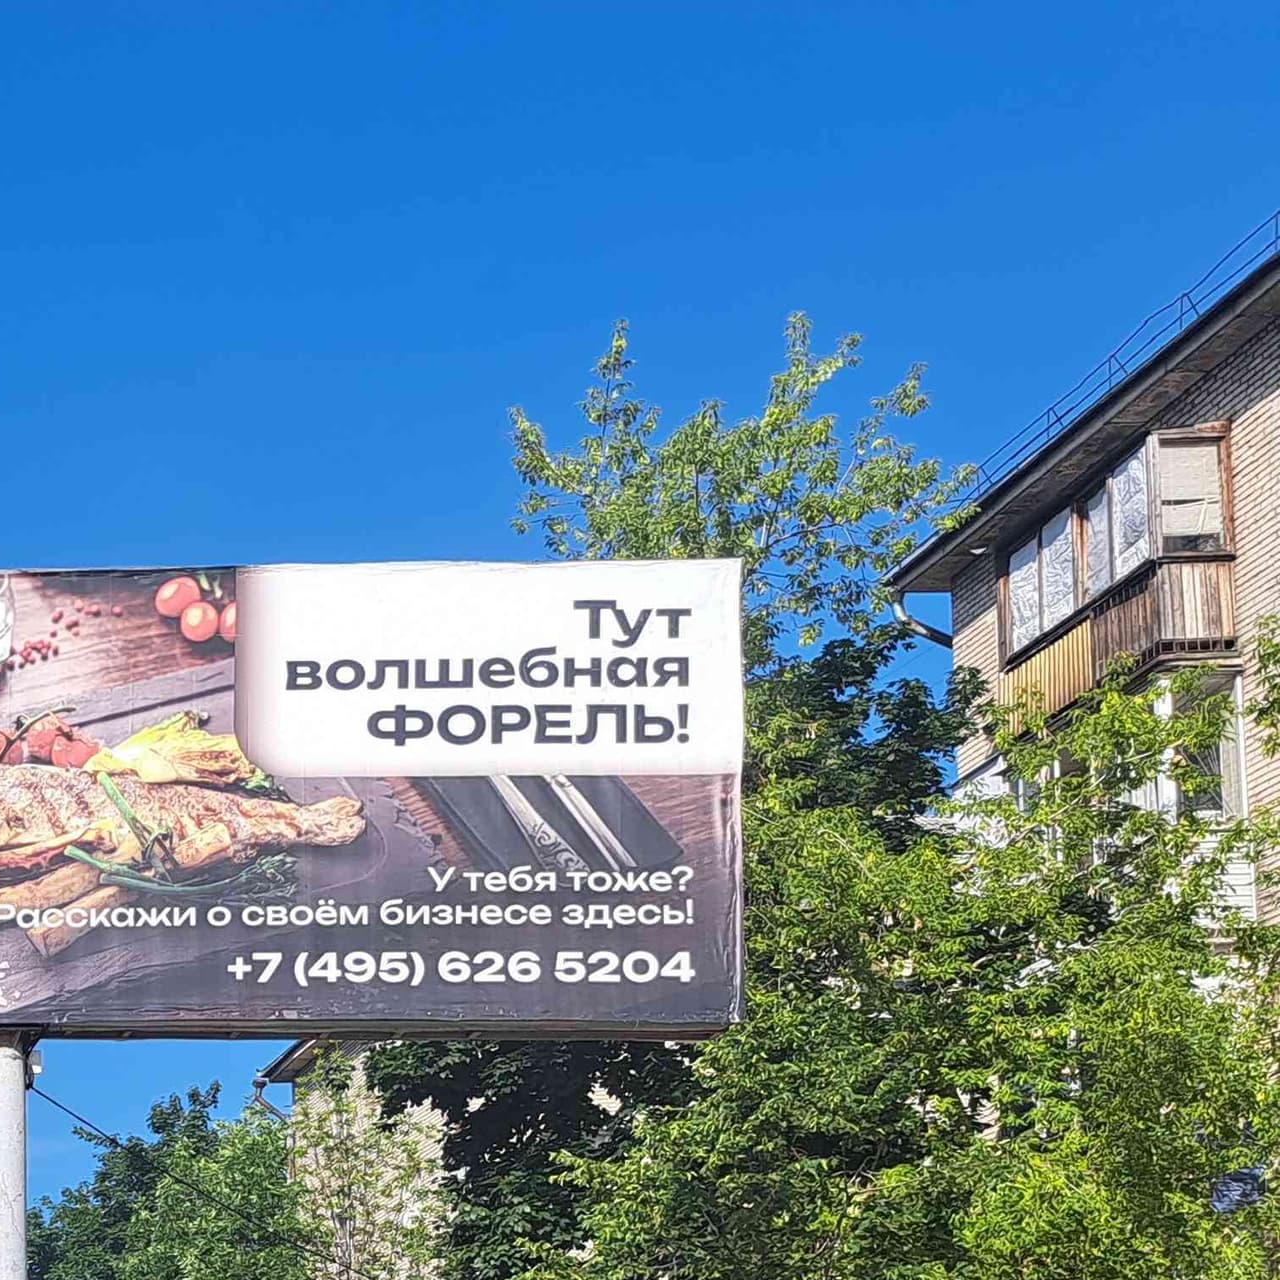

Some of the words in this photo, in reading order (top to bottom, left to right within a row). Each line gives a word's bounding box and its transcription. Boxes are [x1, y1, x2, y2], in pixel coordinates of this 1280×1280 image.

[573, 599, 692, 649] Тут
[285, 645, 690, 691] волшебная
[366, 703, 690, 747] ФОРЕЛЬ!
[427, 866, 456, 892] У
[462, 865, 557, 893] тебя
[565, 864, 695, 892] тоже?
[206, 904, 232, 927] о
[241, 899, 369, 927] своём
[379, 898, 552, 925] бизнесе
[562, 898, 695, 929] здесь!
[227, 952, 283, 984] +7
[293, 951, 425, 987] (495)
[438, 951, 541, 983] 626
[553, 951, 696, 983] 5204
